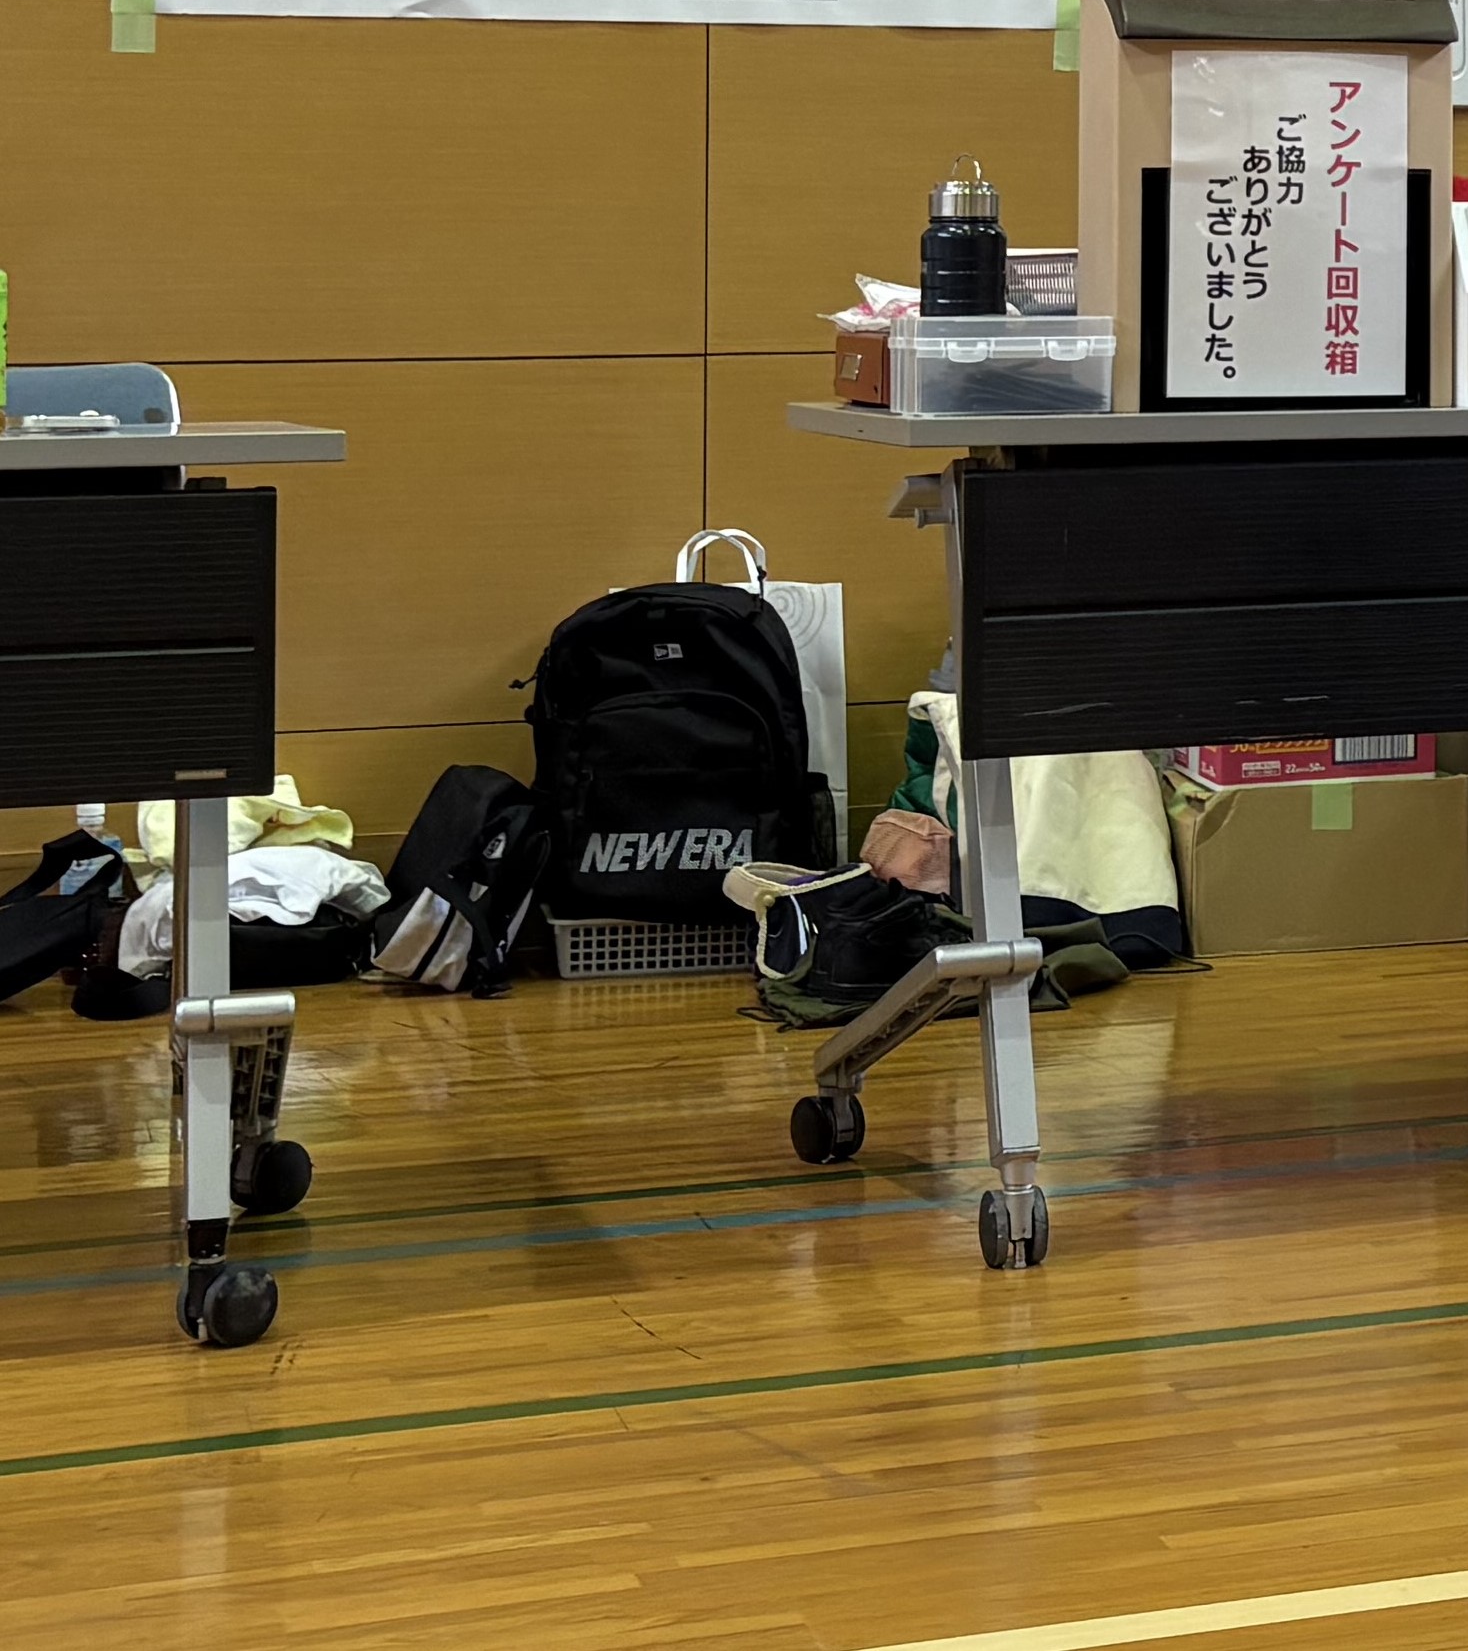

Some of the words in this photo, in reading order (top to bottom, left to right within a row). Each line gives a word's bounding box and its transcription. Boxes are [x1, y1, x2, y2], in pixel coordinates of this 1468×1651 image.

[1240, 145, 1272, 301] ありがとう
[1276, 112, 1307, 206] ご協力
[1324, 80, 1363, 377] アンケート回収箱
[1204, 176, 1239, 380] ございました。
[579, 828, 682, 874] NEW
[679, 827, 755, 872] ERA
